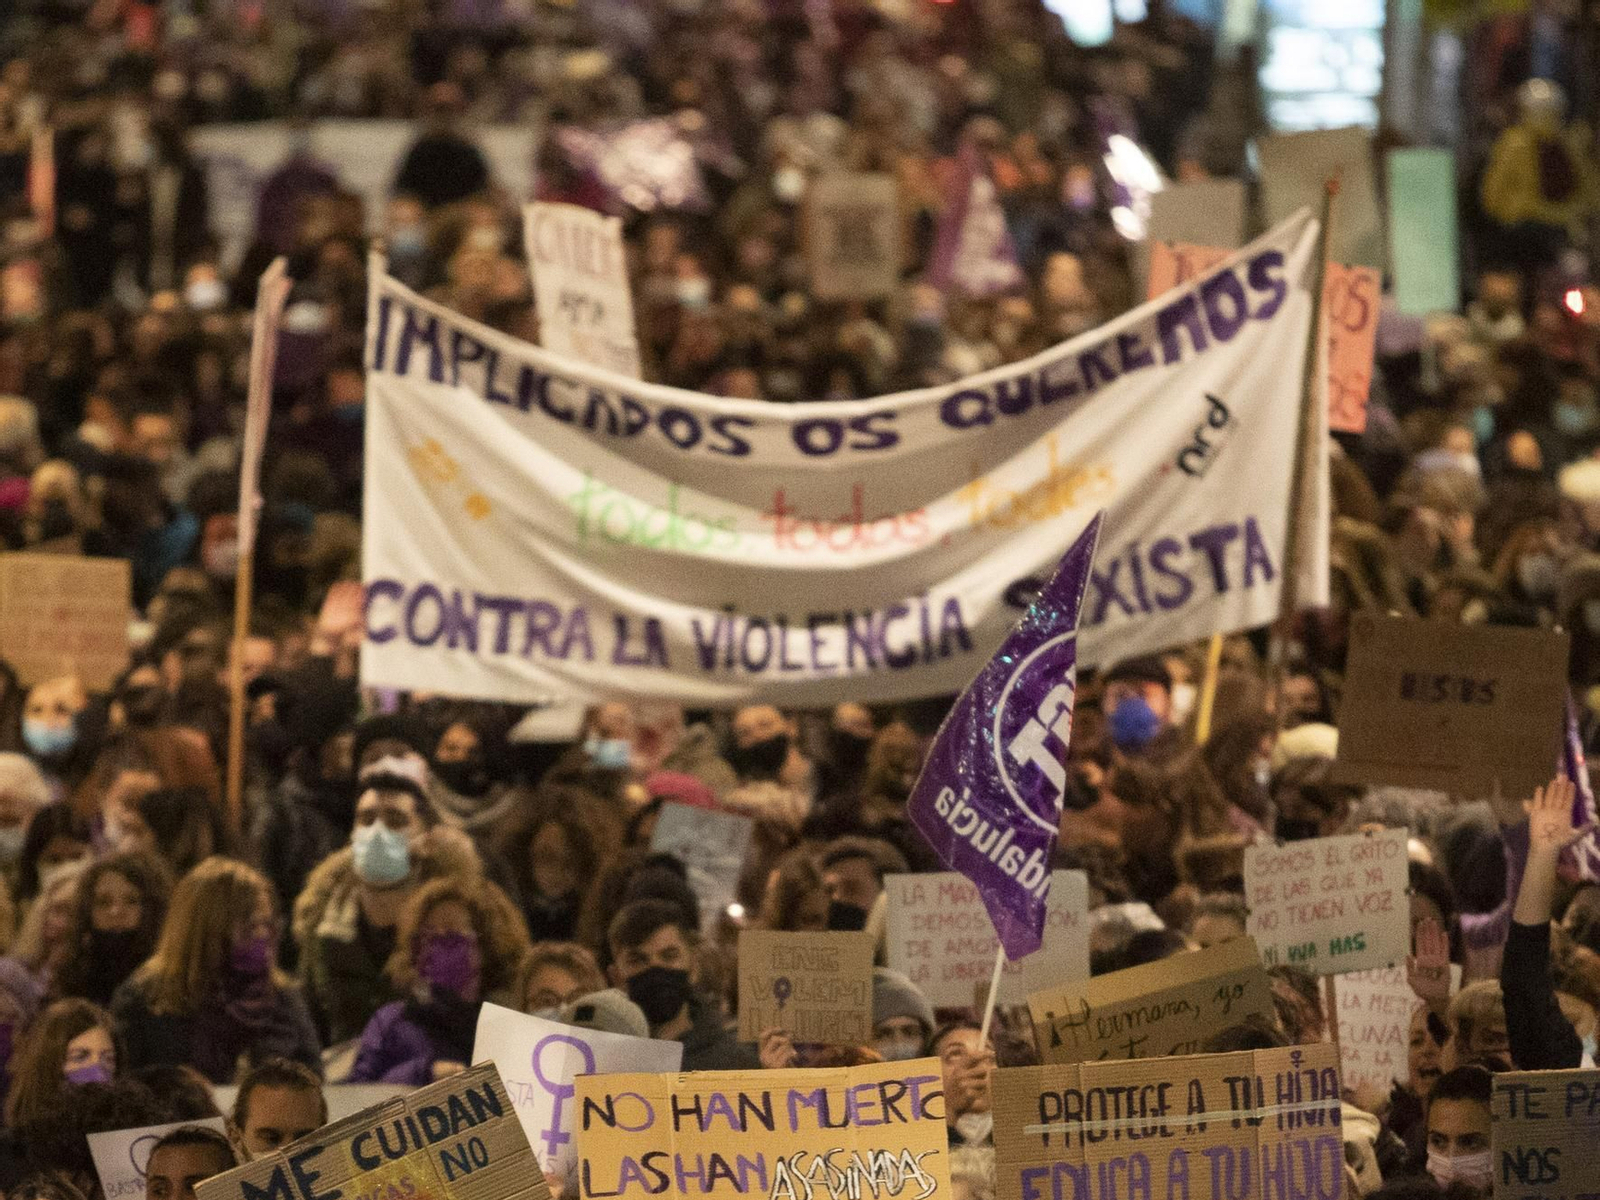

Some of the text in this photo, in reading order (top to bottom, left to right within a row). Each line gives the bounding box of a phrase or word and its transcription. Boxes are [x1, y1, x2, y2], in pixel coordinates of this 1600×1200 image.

[373, 251, 1287, 457] IMPLICADOS OS QUEREMOS
[364, 580, 594, 662] CONTRA
[612, 615, 669, 667] LA
[1325, 845, 1342, 866] EL
[902, 883, 927, 906] LA
[1254, 867, 1384, 904] DE LAS QUE YA
[1257, 891, 1394, 931] NO TIENEN VOZ
[905, 940, 931, 959] DE
[1329, 932, 1367, 956] MAS
[909, 964, 931, 983] LA
[1213, 980, 1250, 1015] yo
[350, 1081, 504, 1172] CUIDAN
[583, 1091, 656, 1133] NO
[671, 1090, 776, 1133] HAN
[1039, 1066, 1342, 1149] PROTEGE A TU HIJA
[439, 1136, 491, 1183] NO
[1502, 1145, 1561, 1186] NOS
